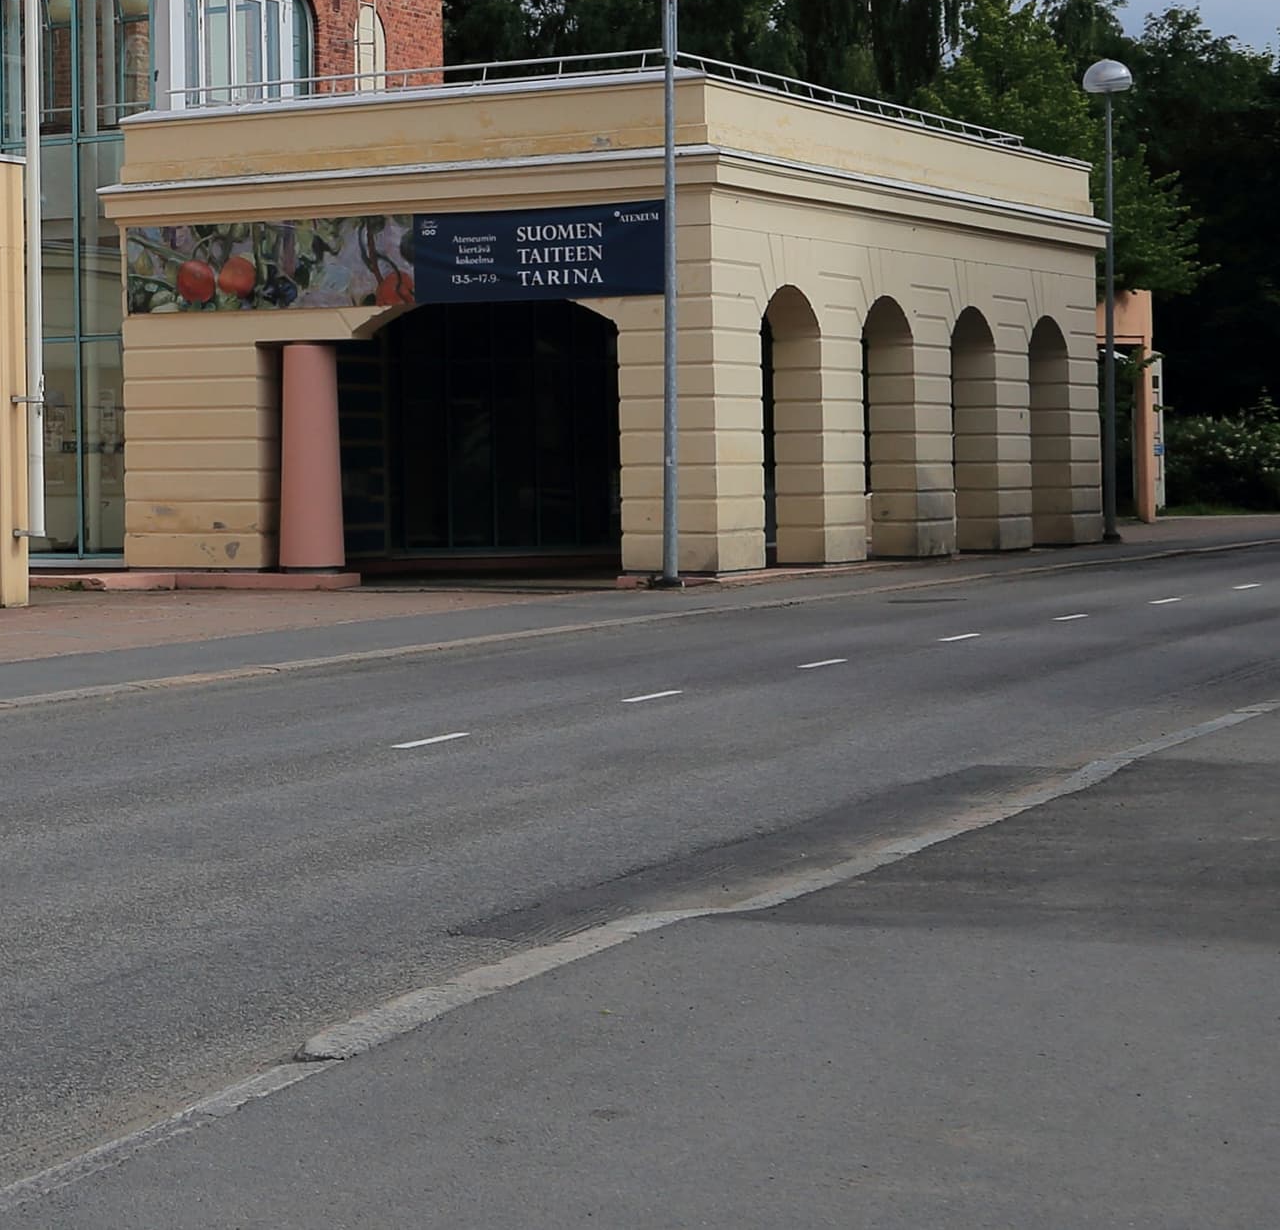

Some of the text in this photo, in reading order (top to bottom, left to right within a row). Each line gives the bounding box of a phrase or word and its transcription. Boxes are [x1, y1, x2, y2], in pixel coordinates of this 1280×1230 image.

[620, 212, 660, 223] ATENEUM
[516, 222, 603, 242] SUOMEN
[452, 234, 497, 243] Ateneumin
[458, 243, 491, 254] kiertävä
[455, 255, 495, 265] kokoelma
[517, 245, 603, 264] TAITEEN
[517, 267, 604, 286] TARINA
